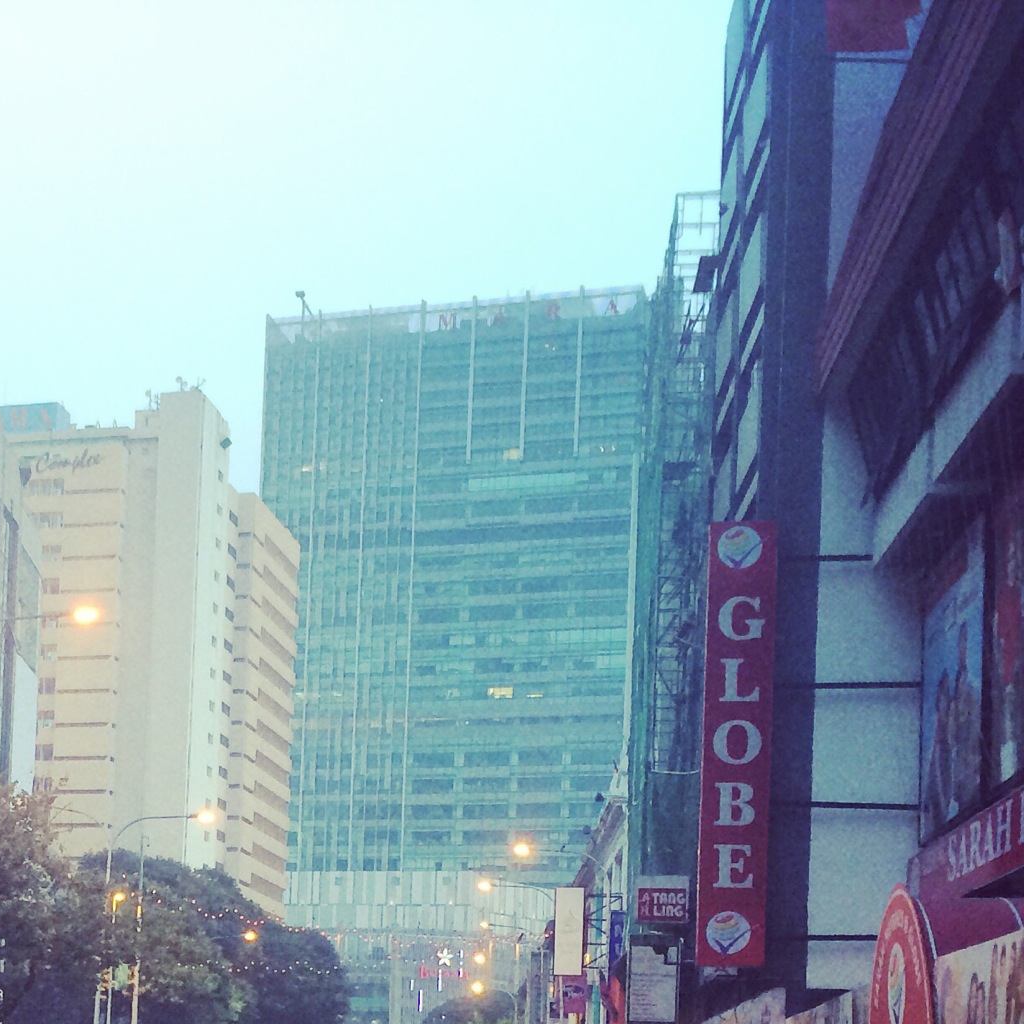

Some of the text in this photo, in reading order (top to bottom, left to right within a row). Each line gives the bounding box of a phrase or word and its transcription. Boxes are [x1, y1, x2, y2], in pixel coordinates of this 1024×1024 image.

[712, 596, 765, 890] GLOBE
[947, 798, 1013, 883] SARAH
[653, 905, 684, 917] LING
